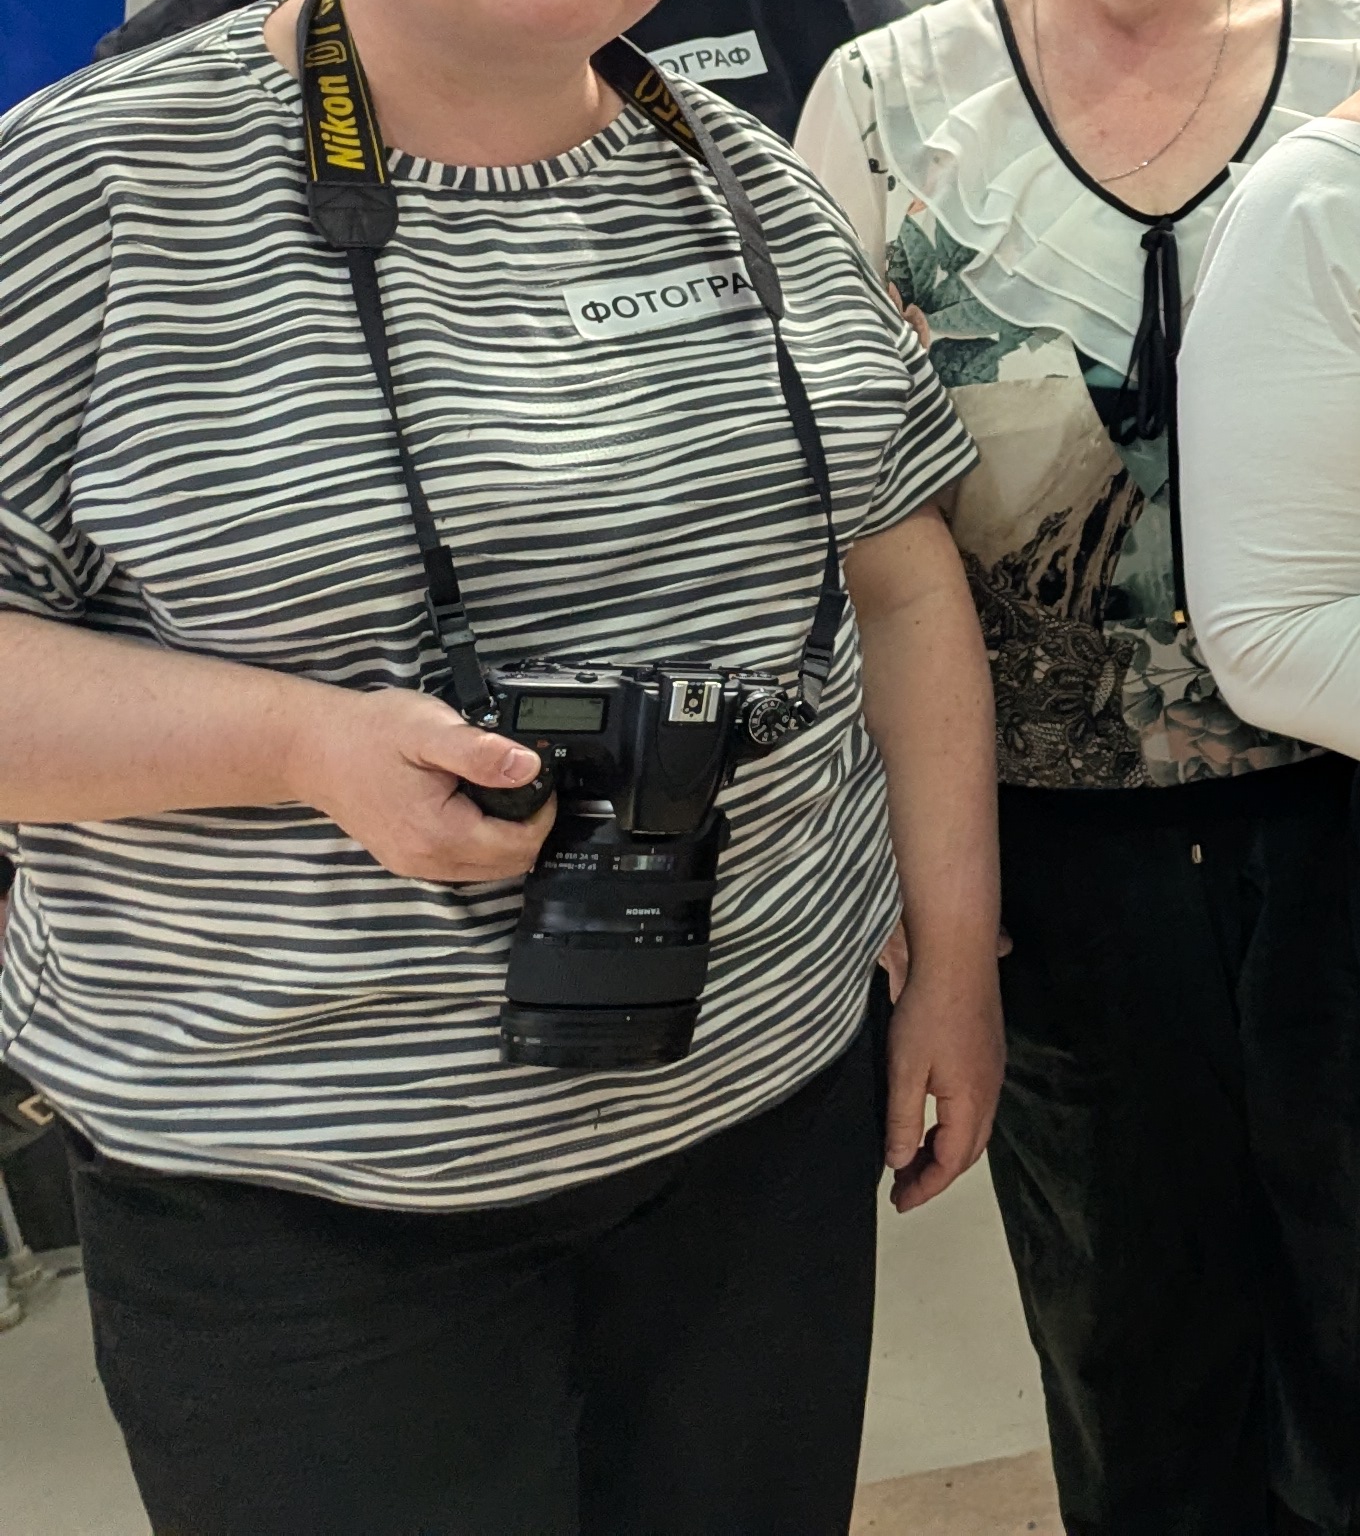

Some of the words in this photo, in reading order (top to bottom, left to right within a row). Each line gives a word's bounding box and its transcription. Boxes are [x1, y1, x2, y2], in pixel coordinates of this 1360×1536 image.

[658, 46, 751, 75] ОГРАФ
[319, 74, 366, 170] Nikon
[580, 271, 757, 324] ФОТОГРА
[625, 907, 661, 916] TAMRON
